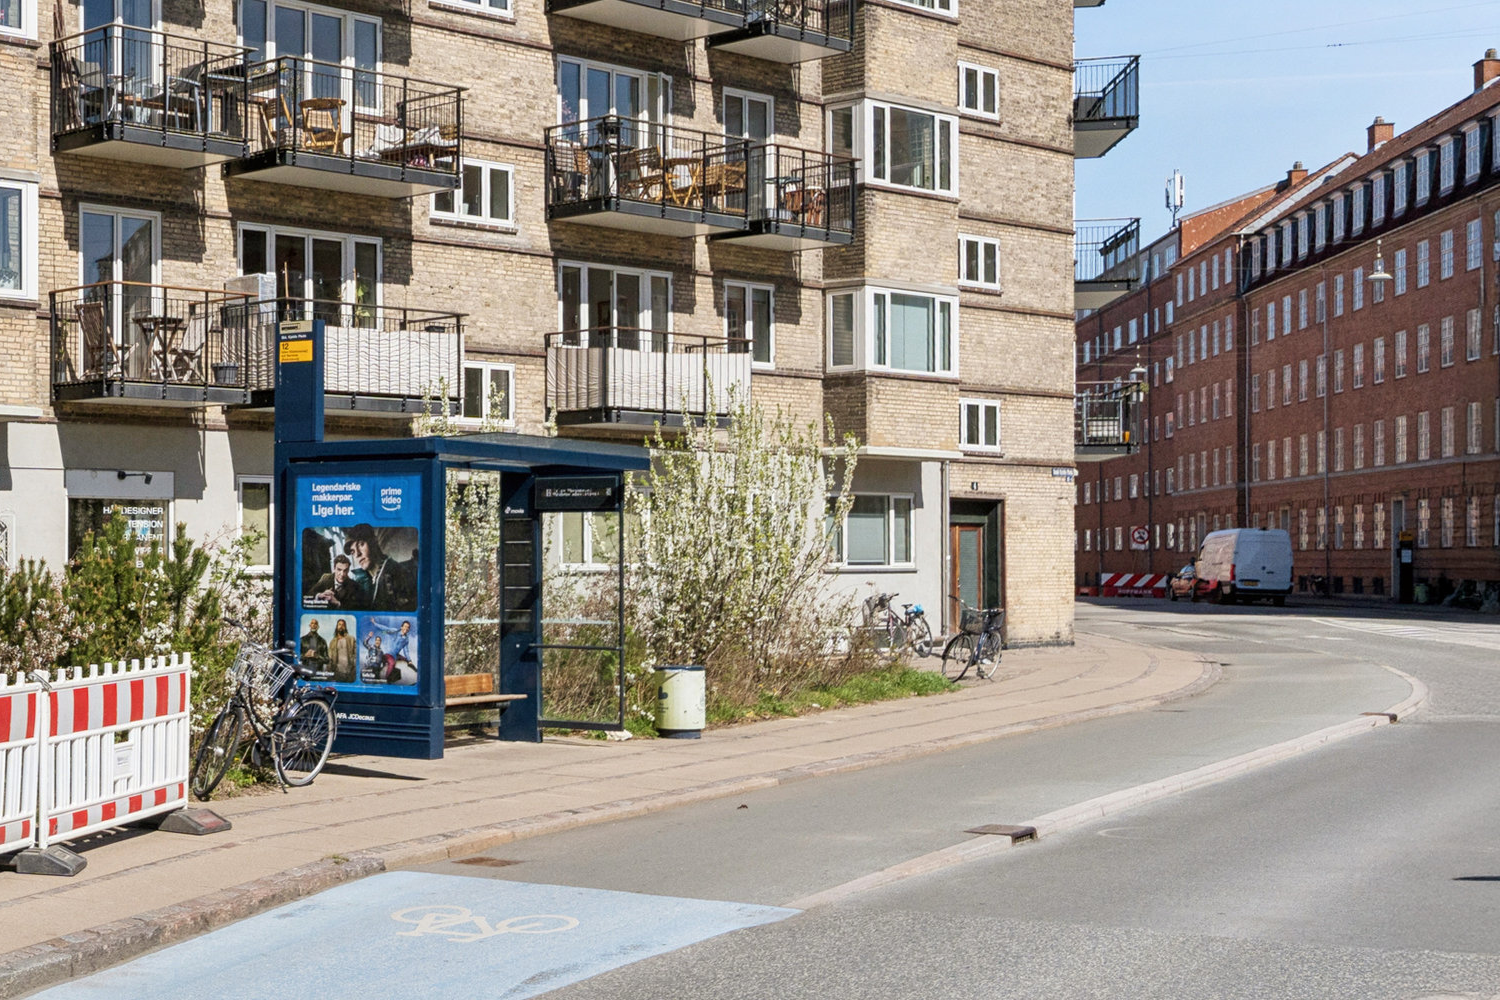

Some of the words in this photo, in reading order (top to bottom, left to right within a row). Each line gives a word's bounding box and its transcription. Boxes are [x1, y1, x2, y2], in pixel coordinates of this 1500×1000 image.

[312, 483, 361, 492] Legendariske
[381, 487, 402, 497] prime
[312, 493, 353, 502] makkerpar.
[381, 496, 402, 504] video
[312, 505, 333, 517] Lige
[335, 505, 355, 516] her.
[348, 713, 375, 721] JCDecaux
